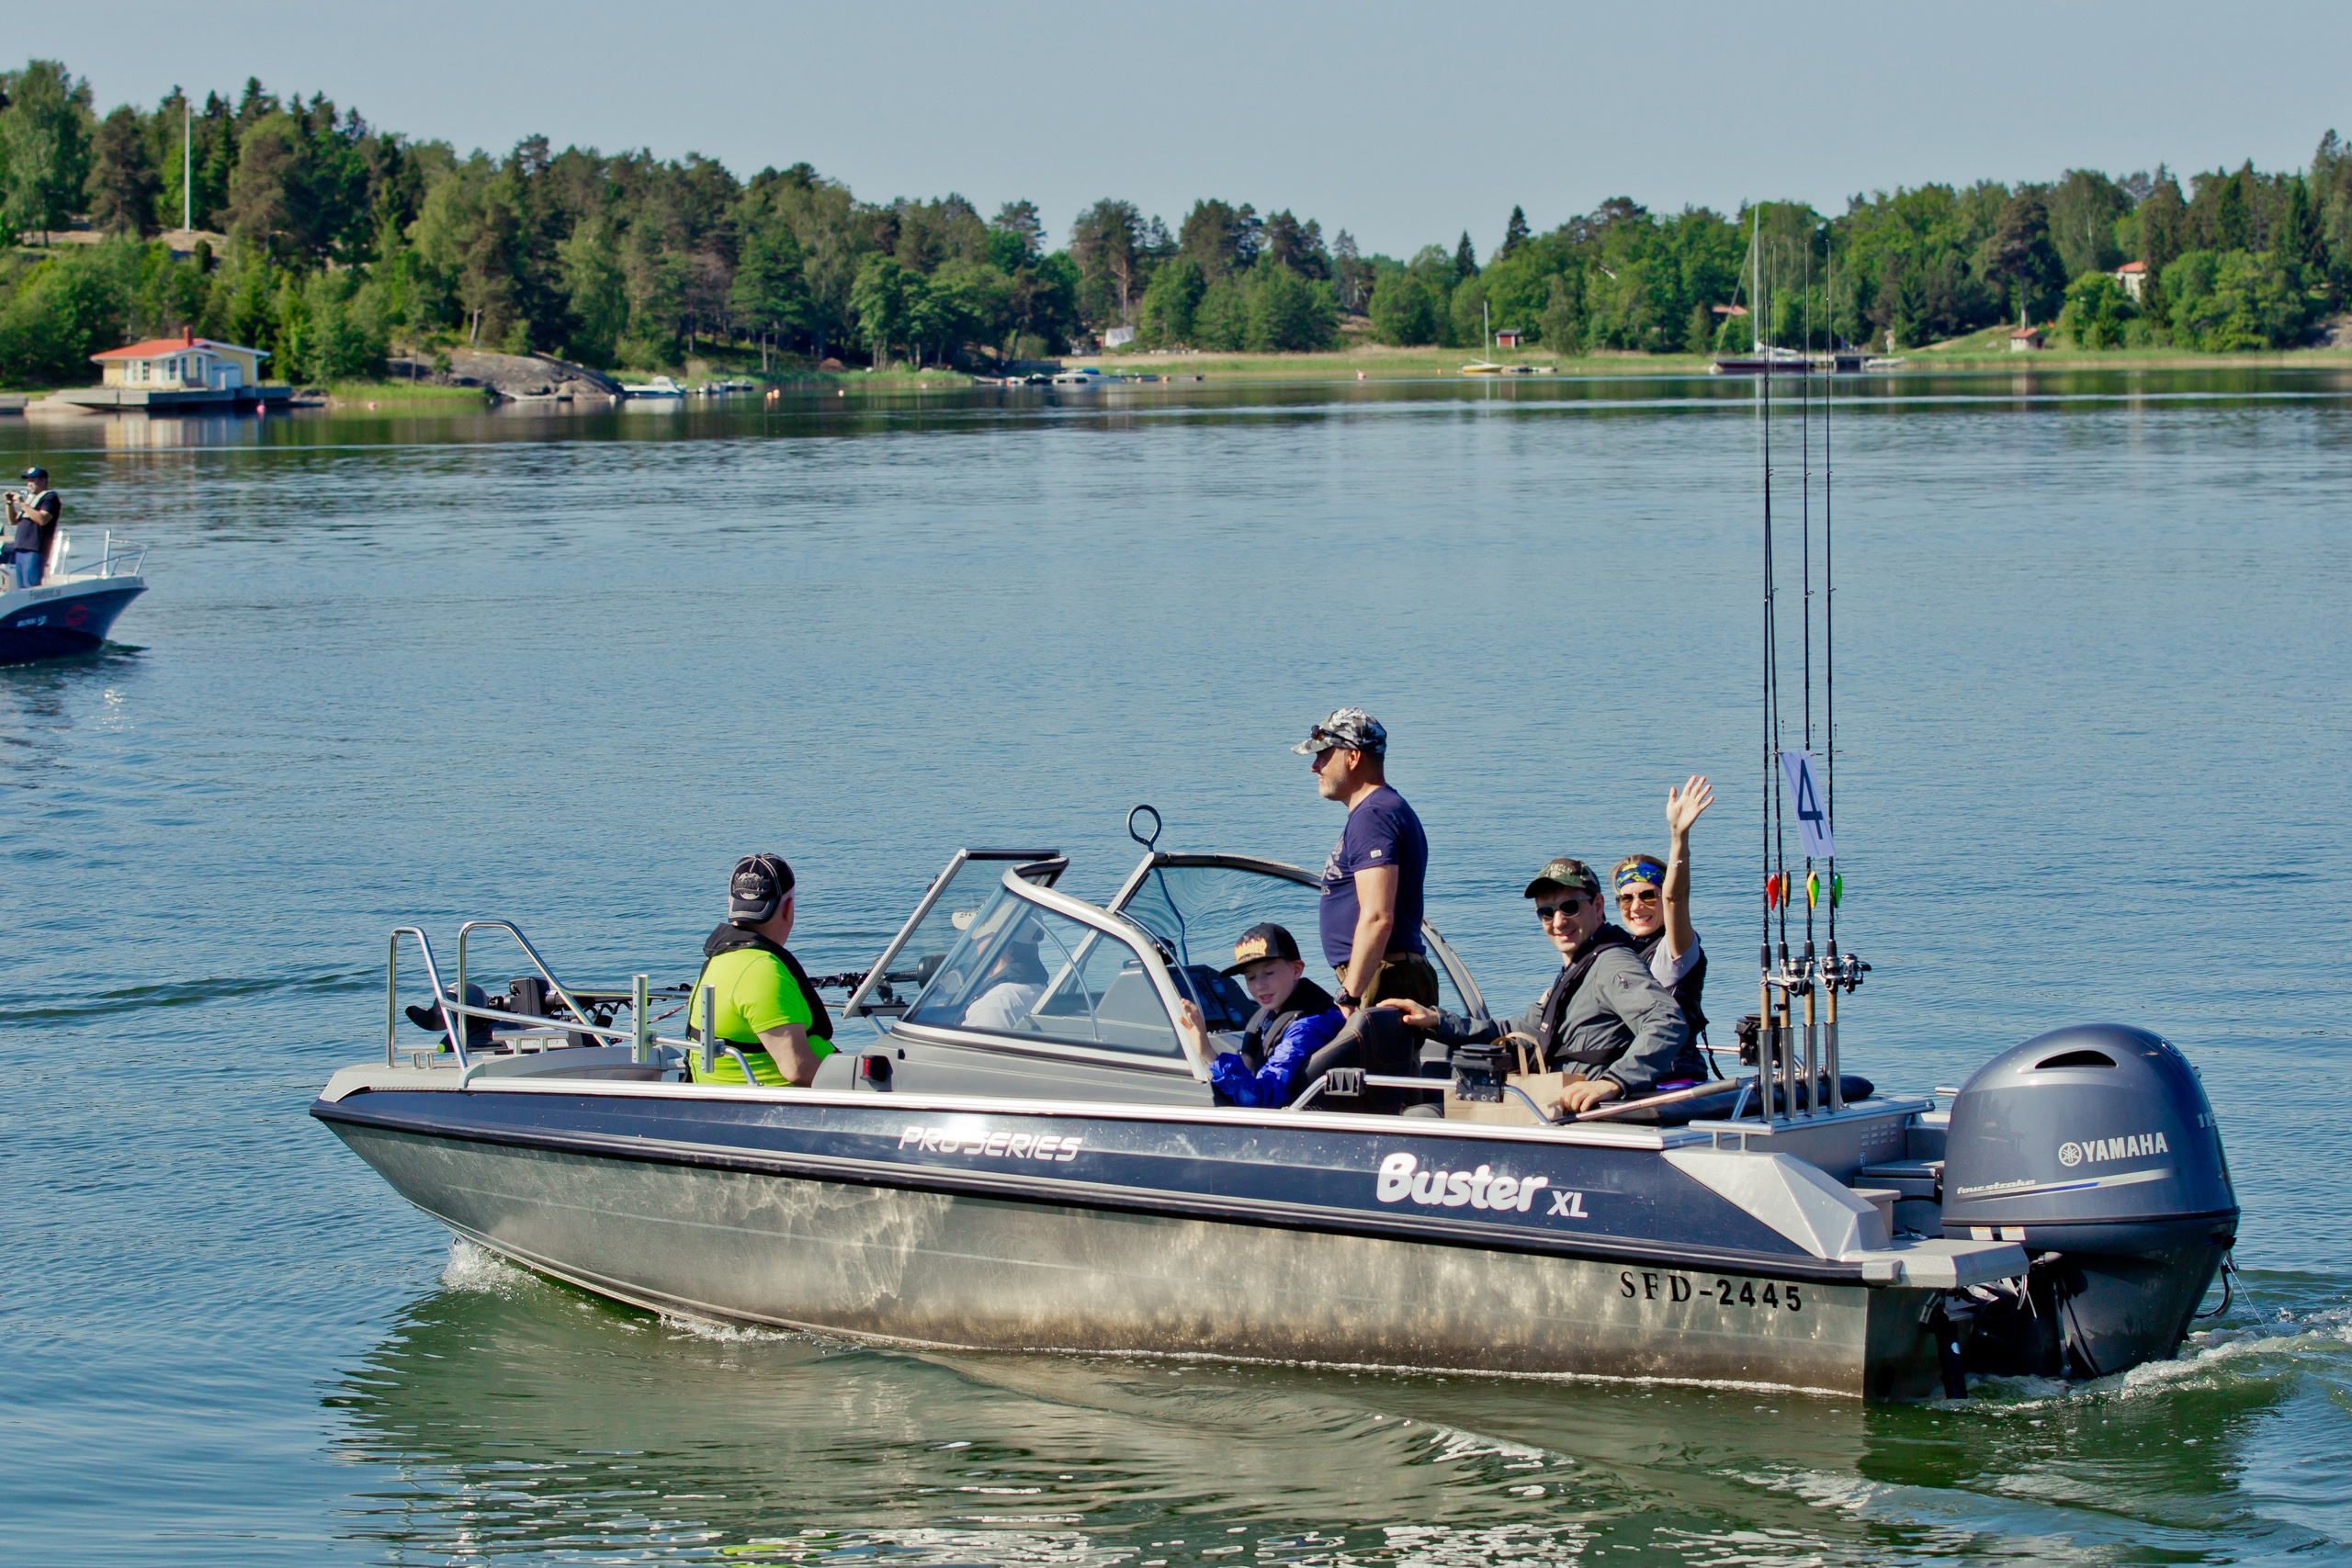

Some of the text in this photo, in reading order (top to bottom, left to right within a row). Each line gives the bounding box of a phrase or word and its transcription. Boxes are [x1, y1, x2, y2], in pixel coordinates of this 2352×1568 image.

[1797, 759, 1824, 840] 4
[898, 1125, 1083, 1162] PRO SERIES
[2082, 1132, 2168, 1163] YAMAHA
[1376, 1152, 1589, 1218] Buster XL
[1620, 1270, 1803, 1312] SFD-2445
